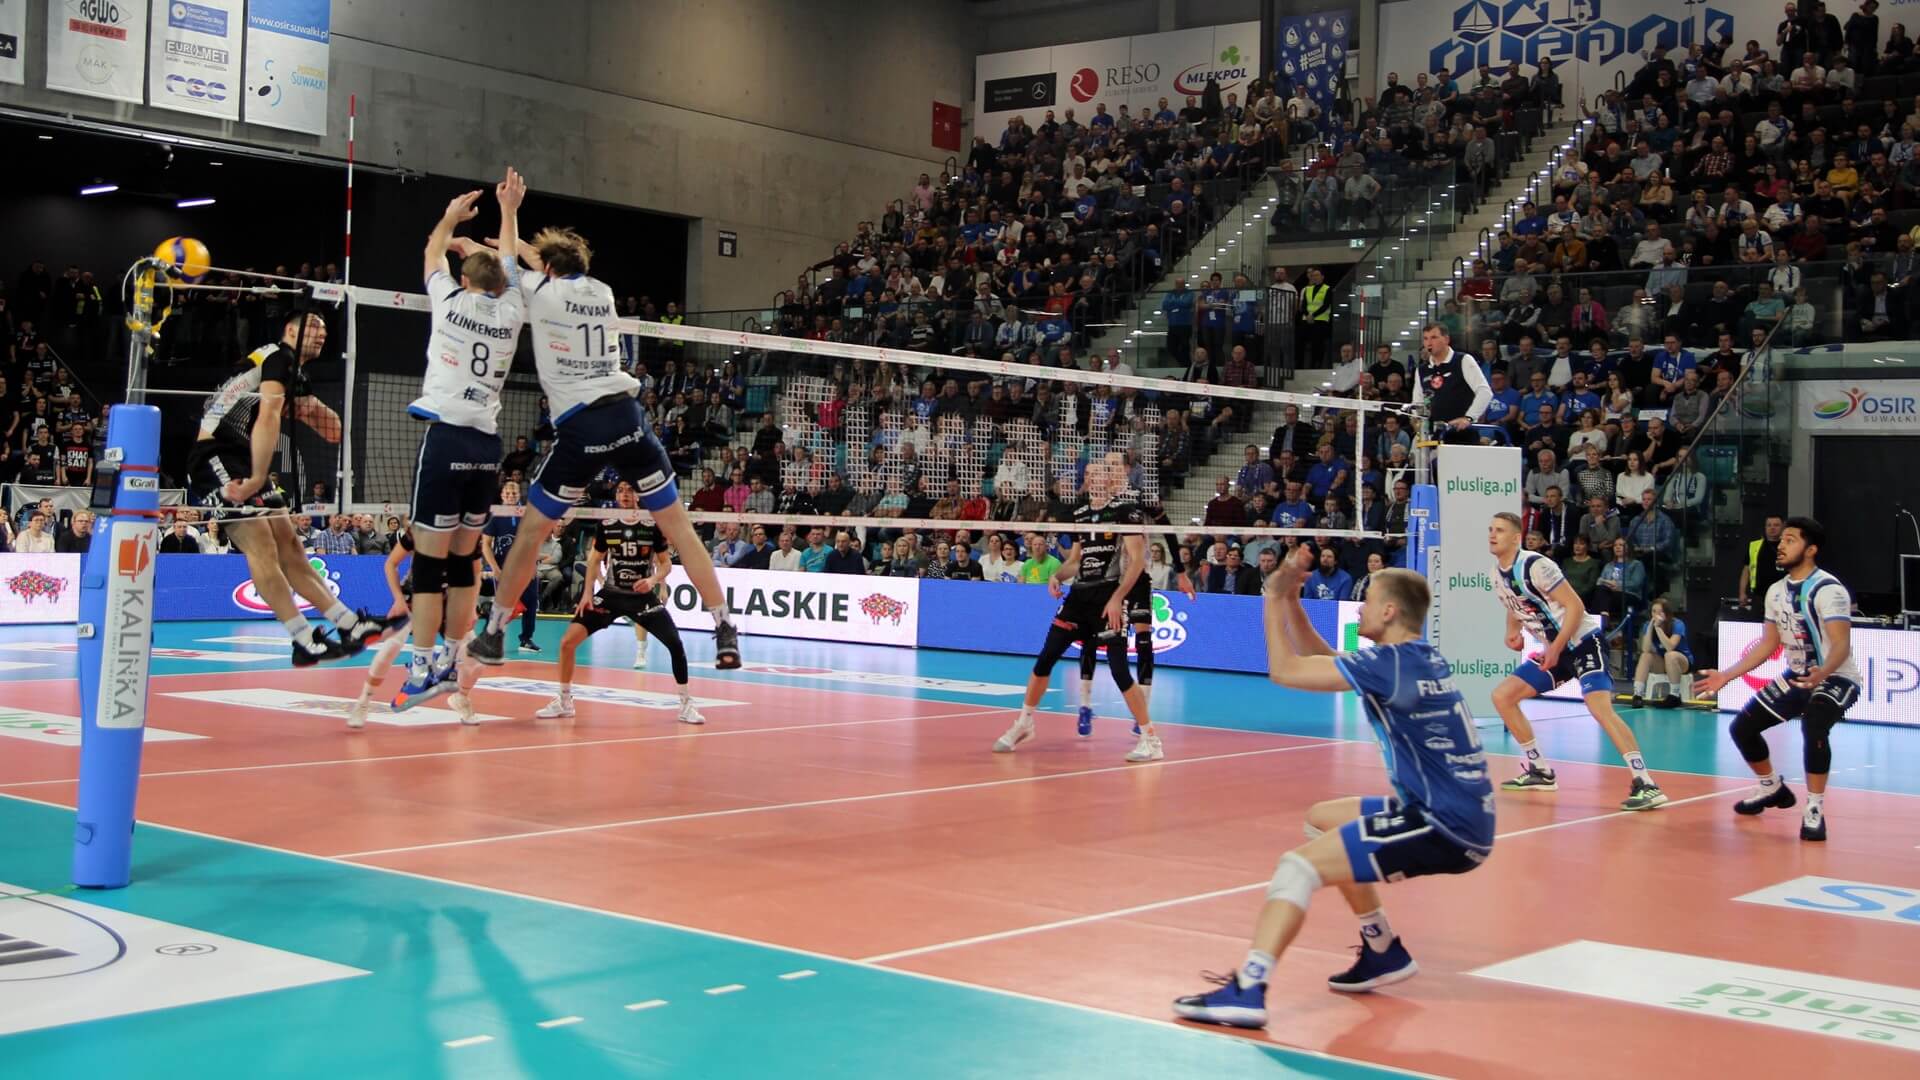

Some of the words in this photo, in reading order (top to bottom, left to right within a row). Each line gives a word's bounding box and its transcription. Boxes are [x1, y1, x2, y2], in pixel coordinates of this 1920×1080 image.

[251, 15, 329, 39] www.osir.suwalki.pl
[1106, 63, 1160, 87] RESO
[1186, 68, 1247, 84] MLEKPOL
[565, 300, 611, 317] TAKVAM
[577, 323, 604, 357] 11
[471, 342, 489, 377] 8
[1862, 397, 1916, 414] OSIR
[1447, 476, 1517, 496] plusliga.pl
[620, 541, 637, 557] 15
